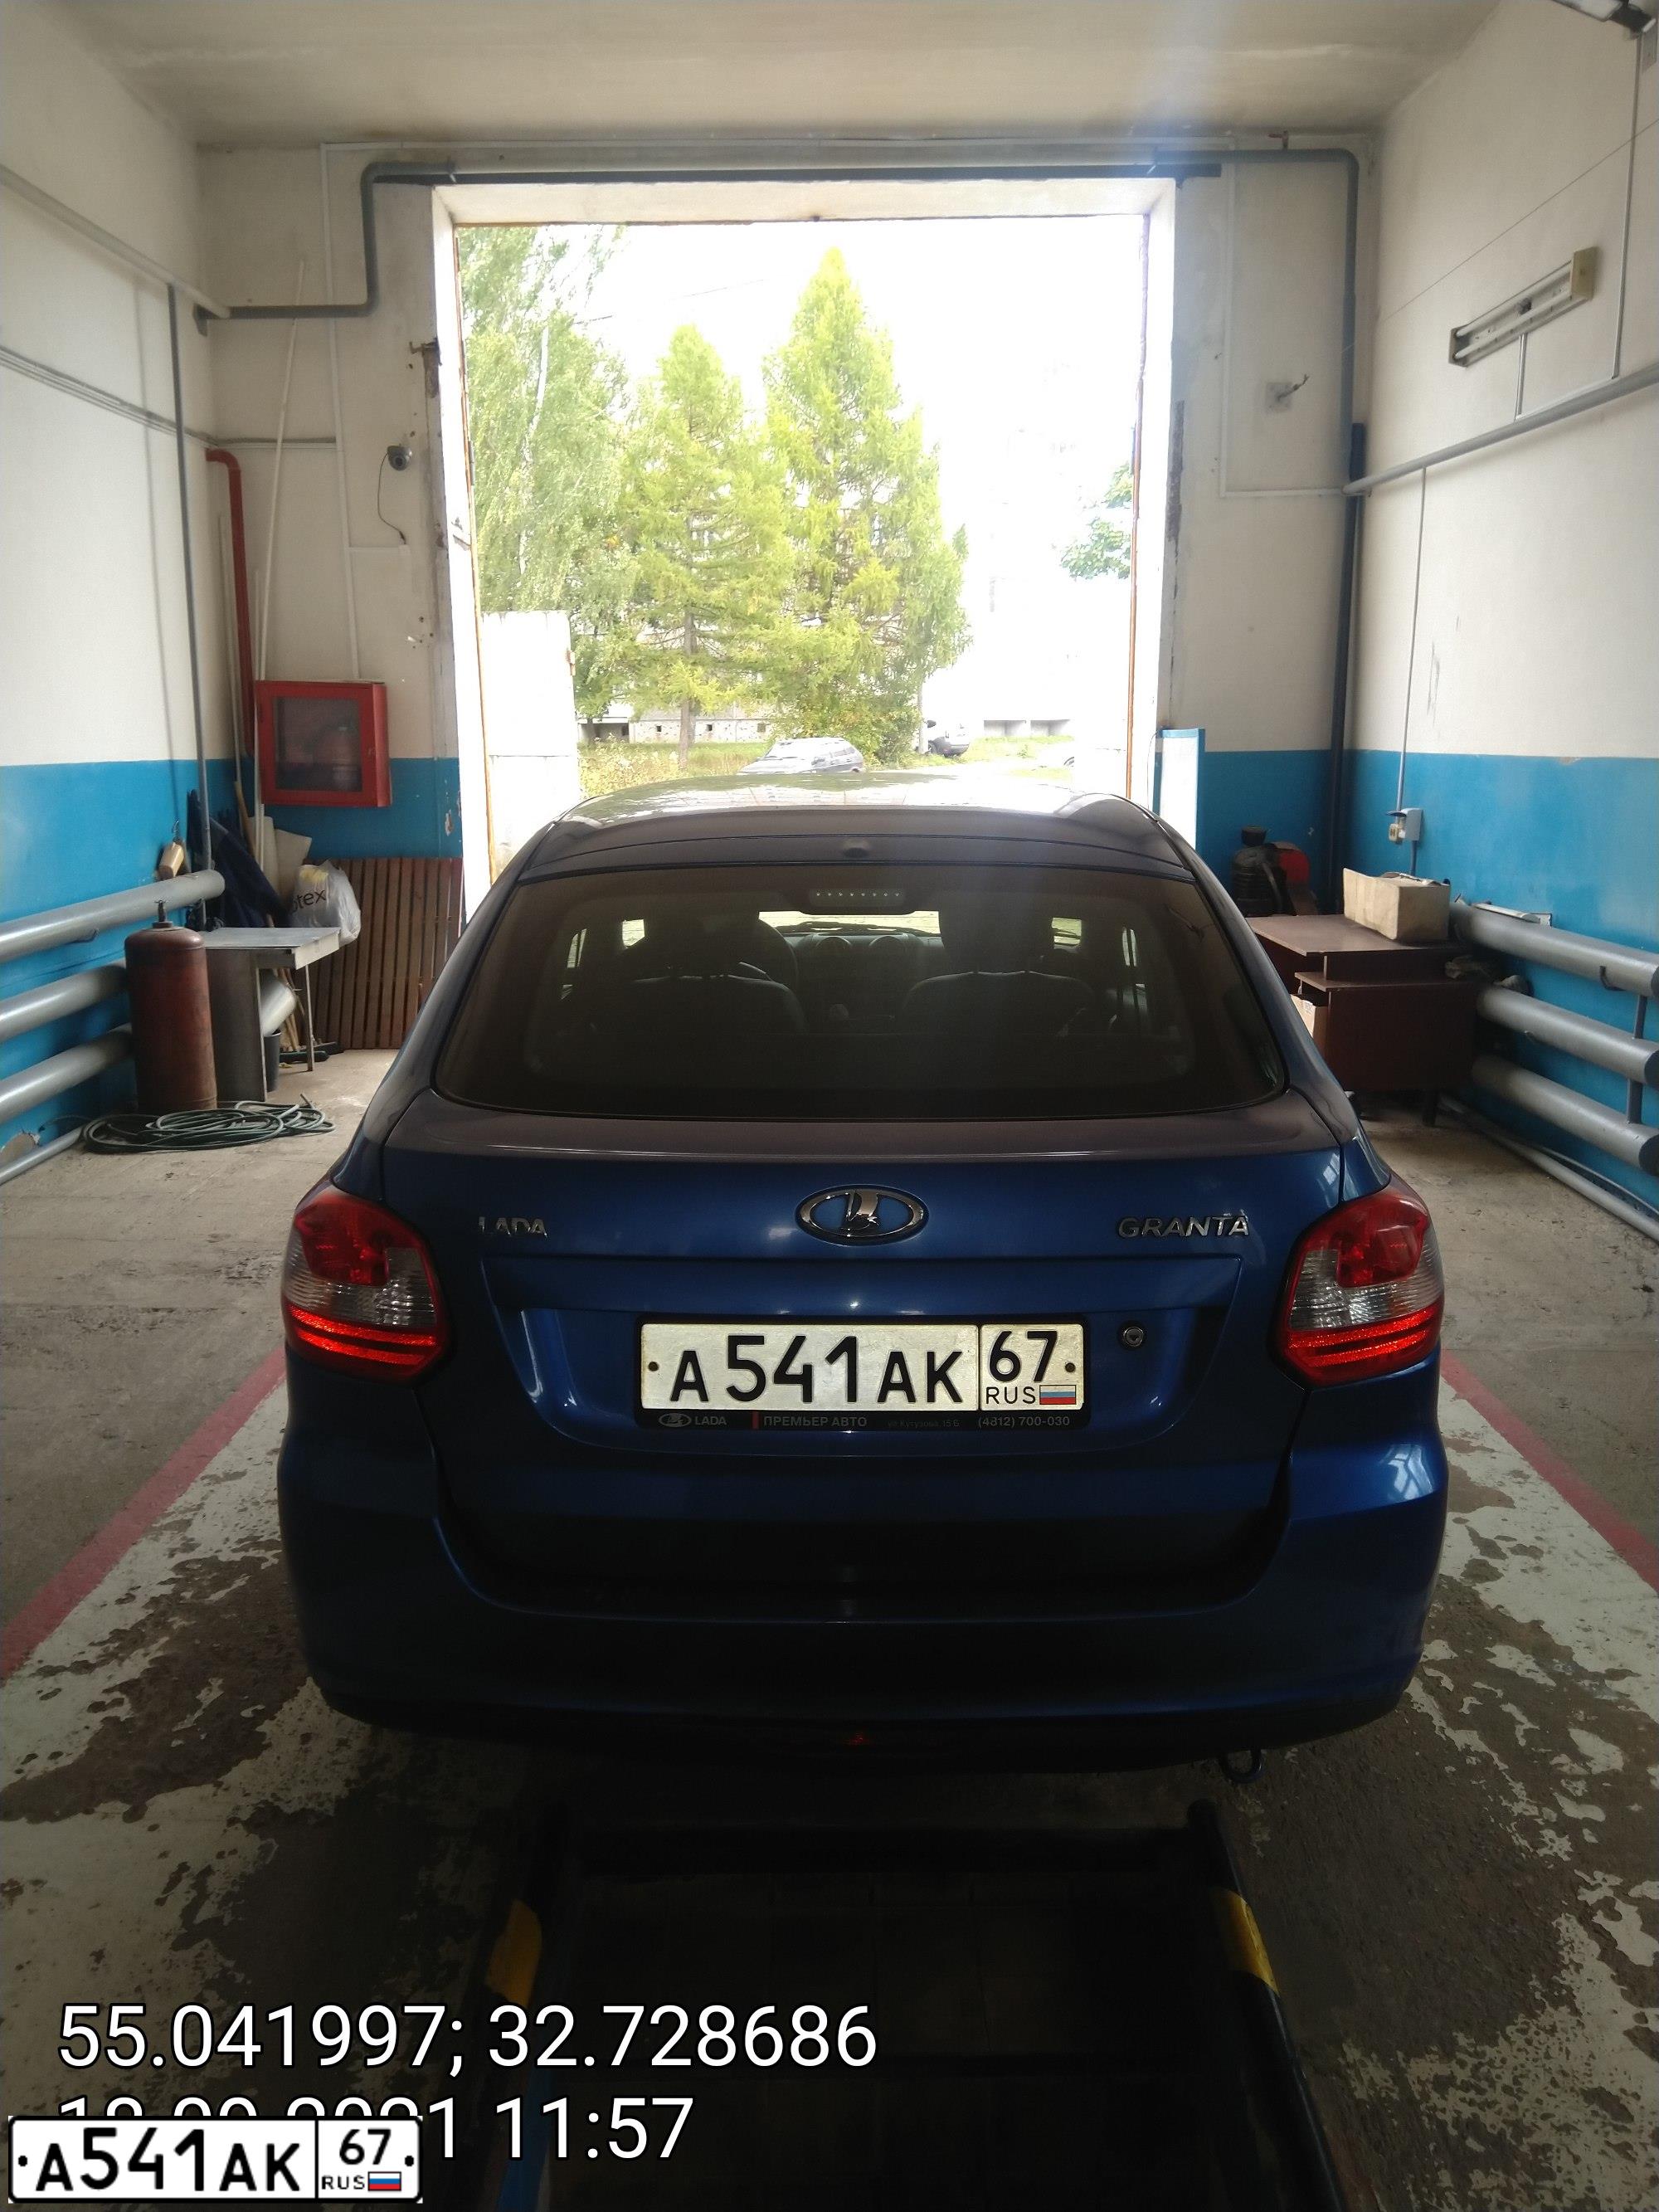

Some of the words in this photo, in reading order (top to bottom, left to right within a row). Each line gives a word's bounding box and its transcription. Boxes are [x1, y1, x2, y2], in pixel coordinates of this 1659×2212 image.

[479, 1216, 548, 1237] LADA
[1118, 1216, 1249, 1237] GRANTA
[670, 1335, 962, 1403] А541АК
[989, 1330, 1058, 1382] 67
[985, 1386, 1036, 1405] RUS
[695, 1415, 727, 1426] LADA
[764, 1416, 828, 1426] ПРЕМЬЕР
[832, 1416, 867, 1427] АВТО
[978, 1415, 1015, 1428] (4812)
[1019, 1415, 1070, 1426] 700-030
